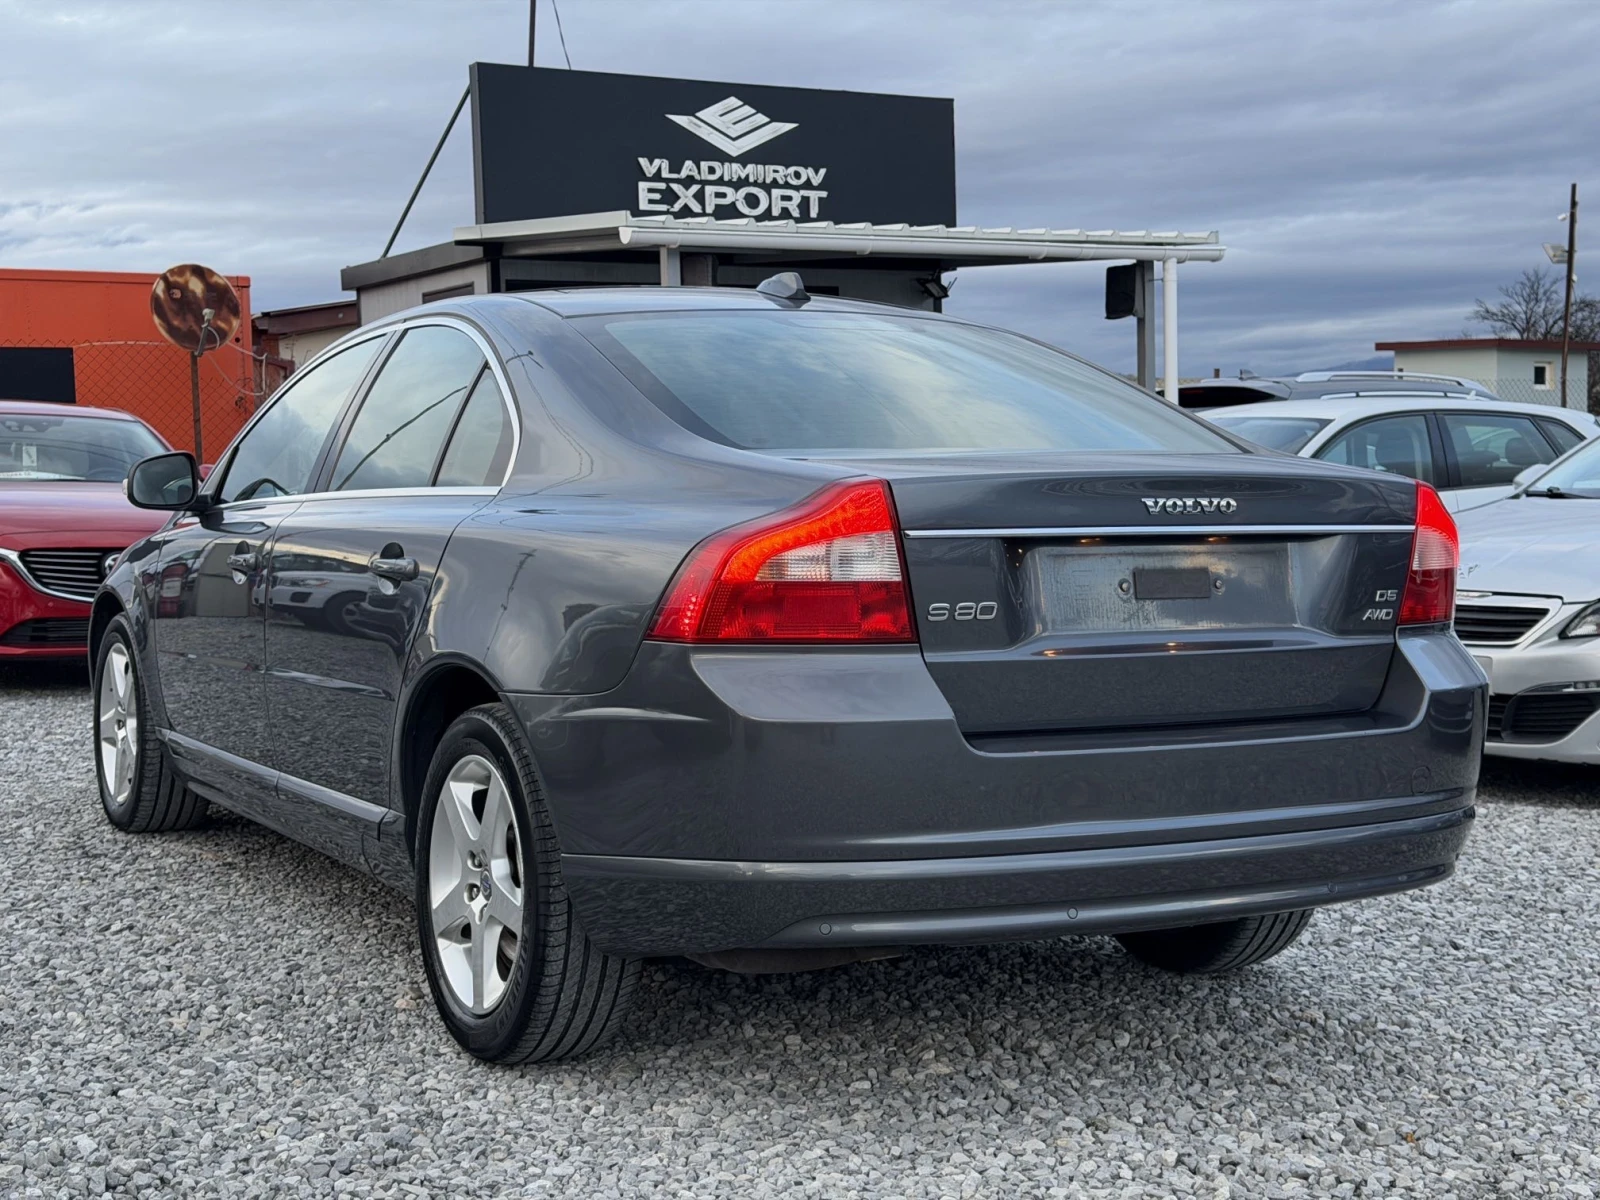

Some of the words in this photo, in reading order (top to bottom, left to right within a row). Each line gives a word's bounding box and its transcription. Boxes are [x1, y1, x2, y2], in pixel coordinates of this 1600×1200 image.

[637, 156, 827, 187] VLADIMIROV
[637, 181, 828, 219] EXPORT
[1141, 497, 1238, 515] VOLVO
[1375, 590, 1399, 602] D5
[1362, 608, 1394, 621] AWD
